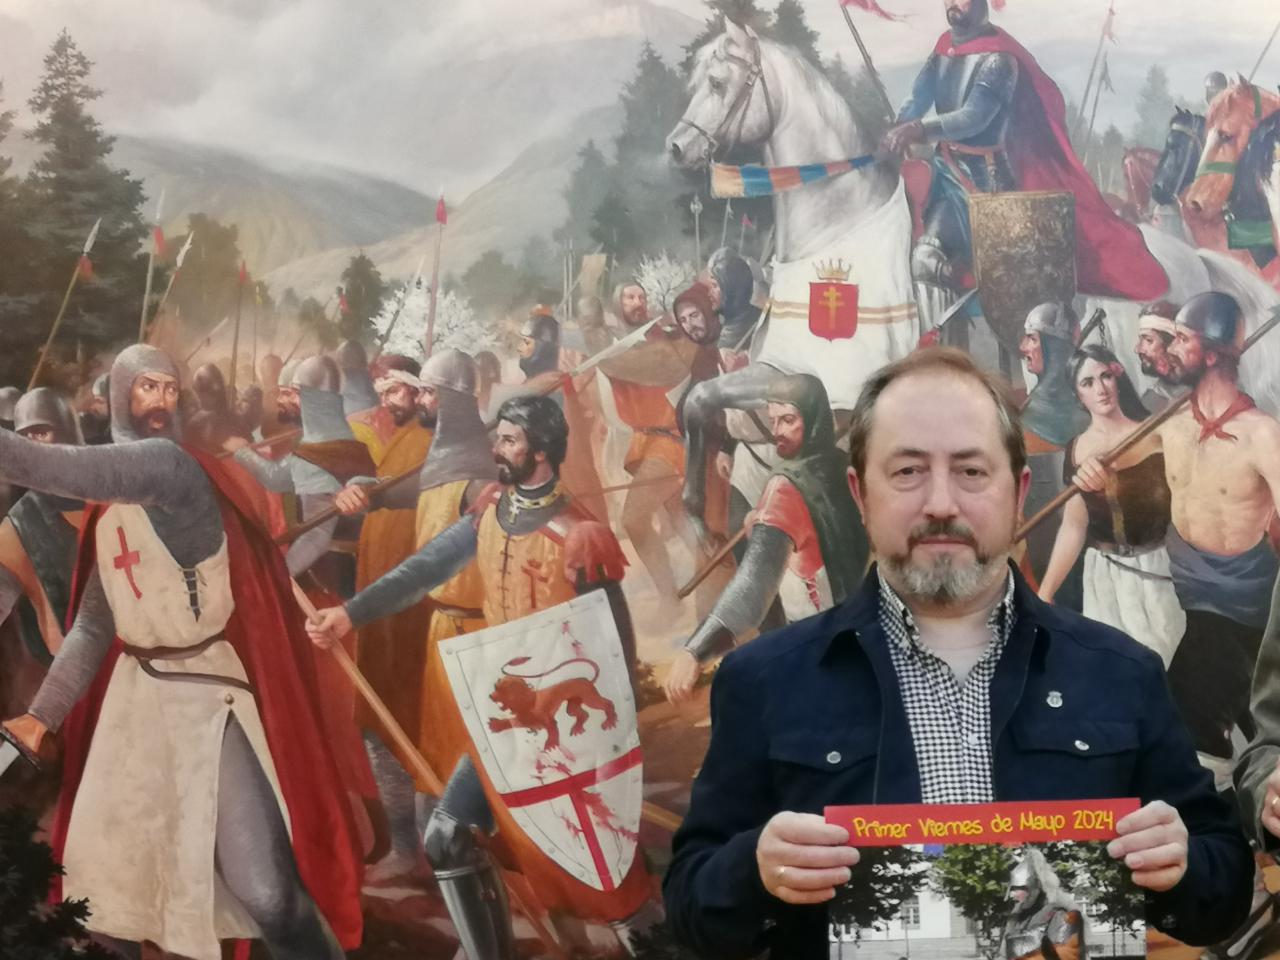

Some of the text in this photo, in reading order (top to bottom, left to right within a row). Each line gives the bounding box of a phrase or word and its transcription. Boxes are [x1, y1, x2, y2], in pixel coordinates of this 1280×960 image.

[853, 810, 1113, 838] Primer Viernes de Mayo 2024
